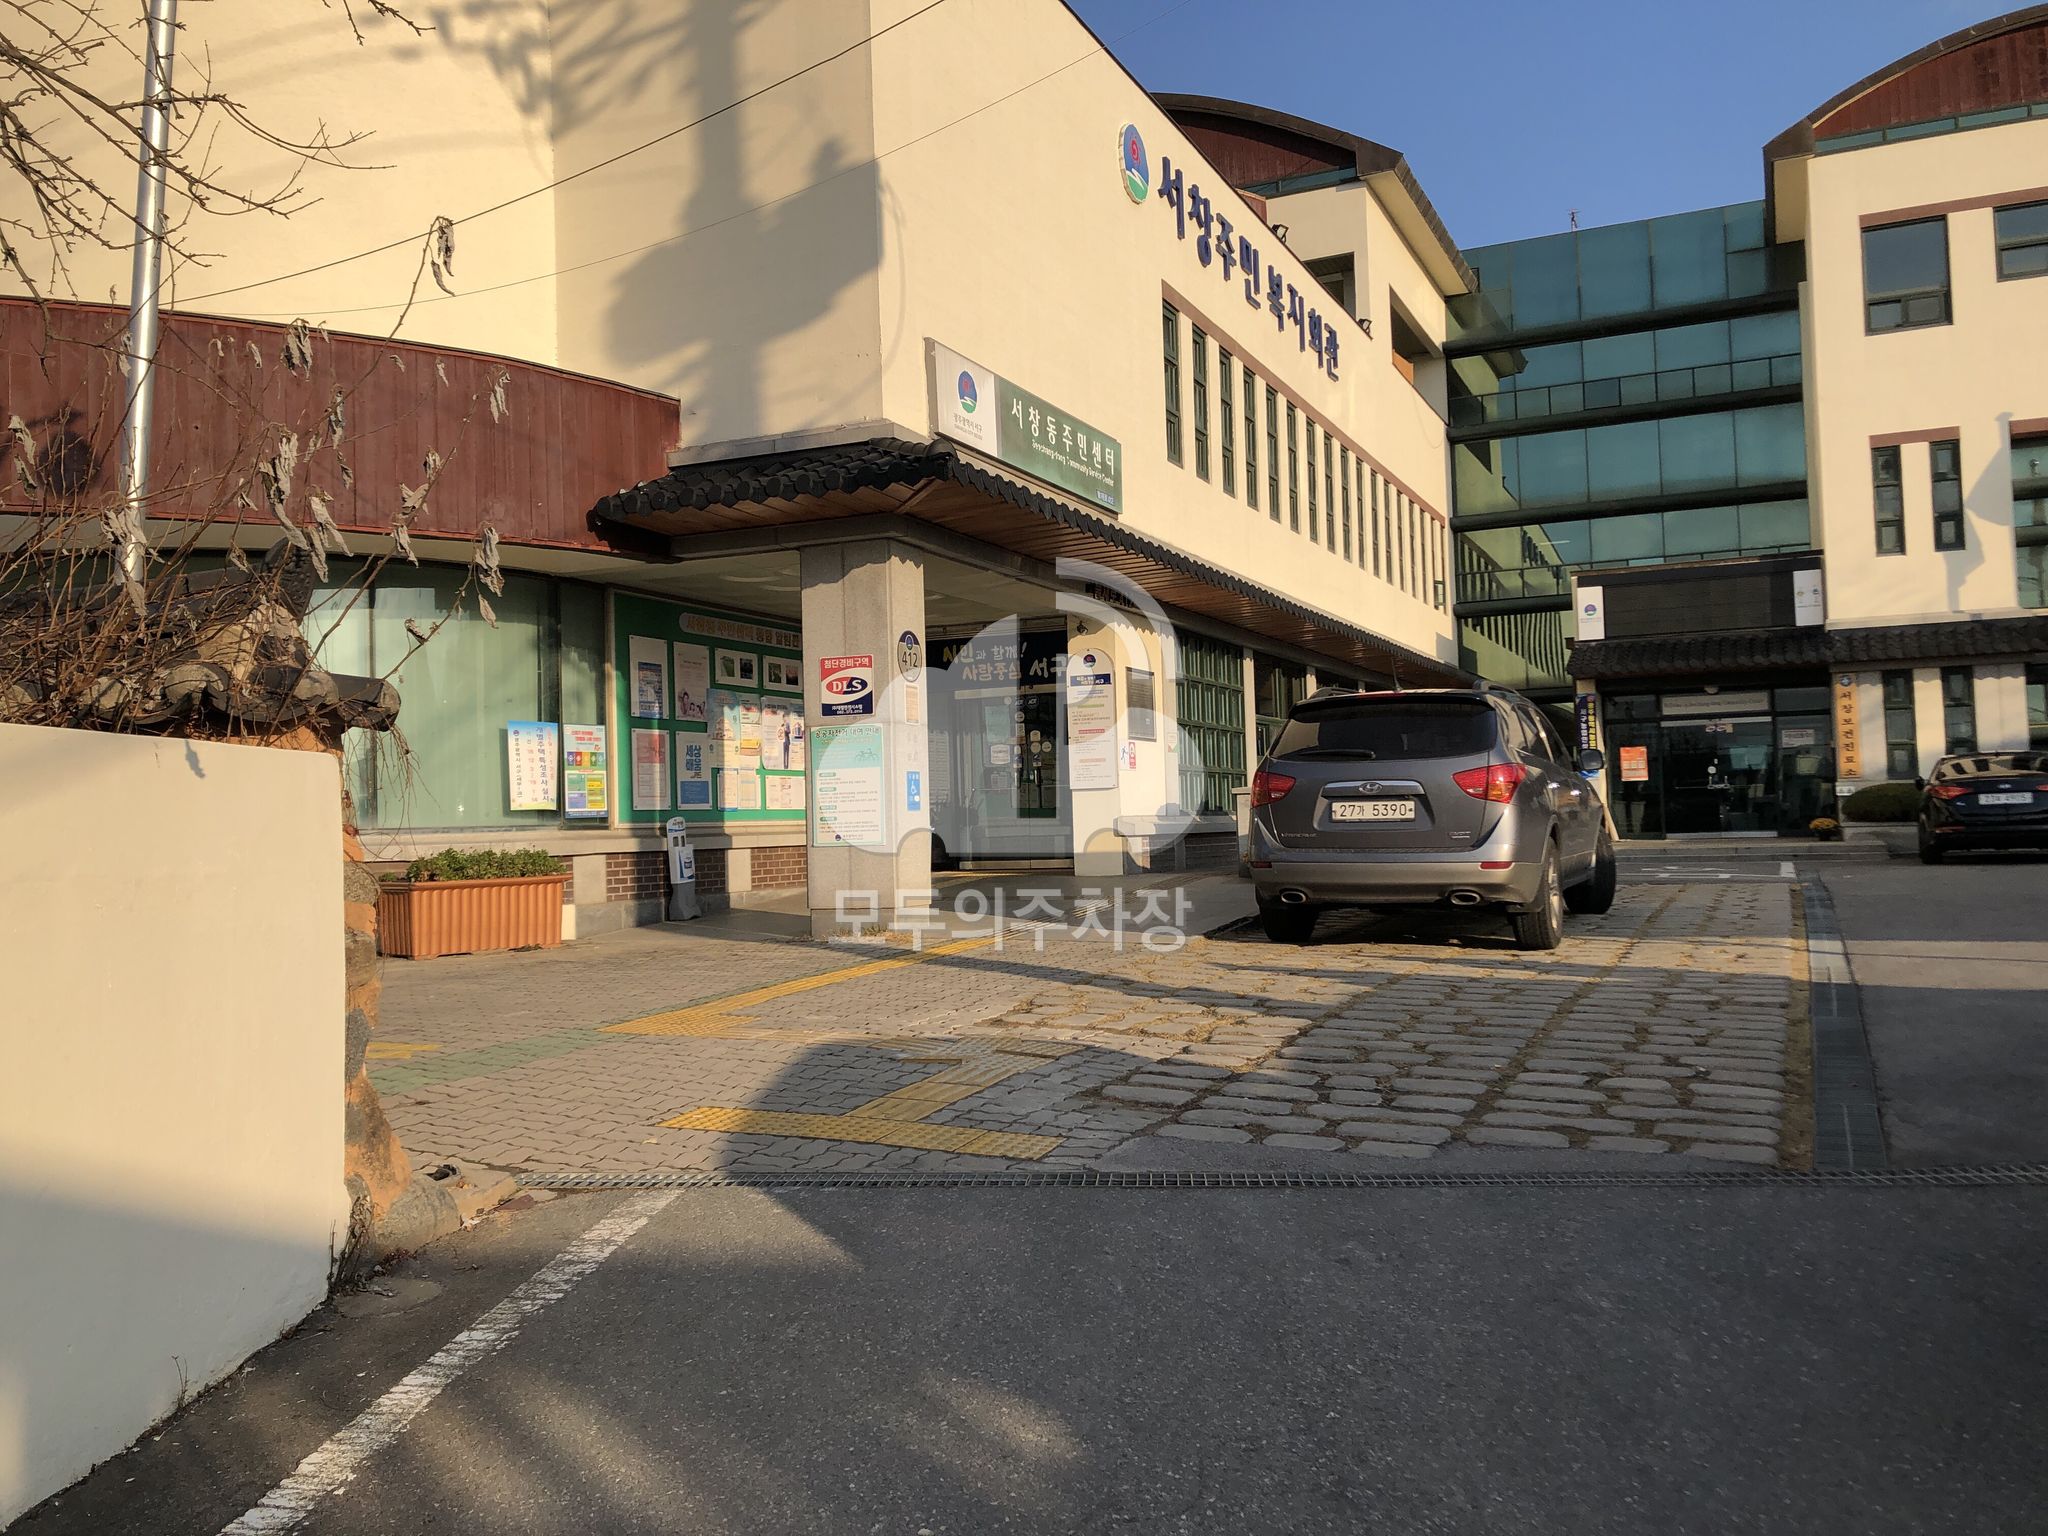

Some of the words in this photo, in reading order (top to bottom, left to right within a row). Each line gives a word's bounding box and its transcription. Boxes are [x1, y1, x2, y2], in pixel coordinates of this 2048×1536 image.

[1157, 156, 1261, 310] 서창주민
[1267, 265, 1340, 383] 복지회관
[1011, 397, 1115, 476] 서창동주민센터
[902, 651, 918, 668] 412
[943, 641, 986, 664] 시민과
[991, 641, 1028, 661] 함께!
[823, 657, 870, 669] 첨단경비구역
[962, 662, 1022, 681] 사람중심
[1029, 655, 1068, 679] 서구
[832, 679, 863, 692] DLS
[1339, 804, 1365, 817] 27가
[1372, 803, 1407, 817] 5390
